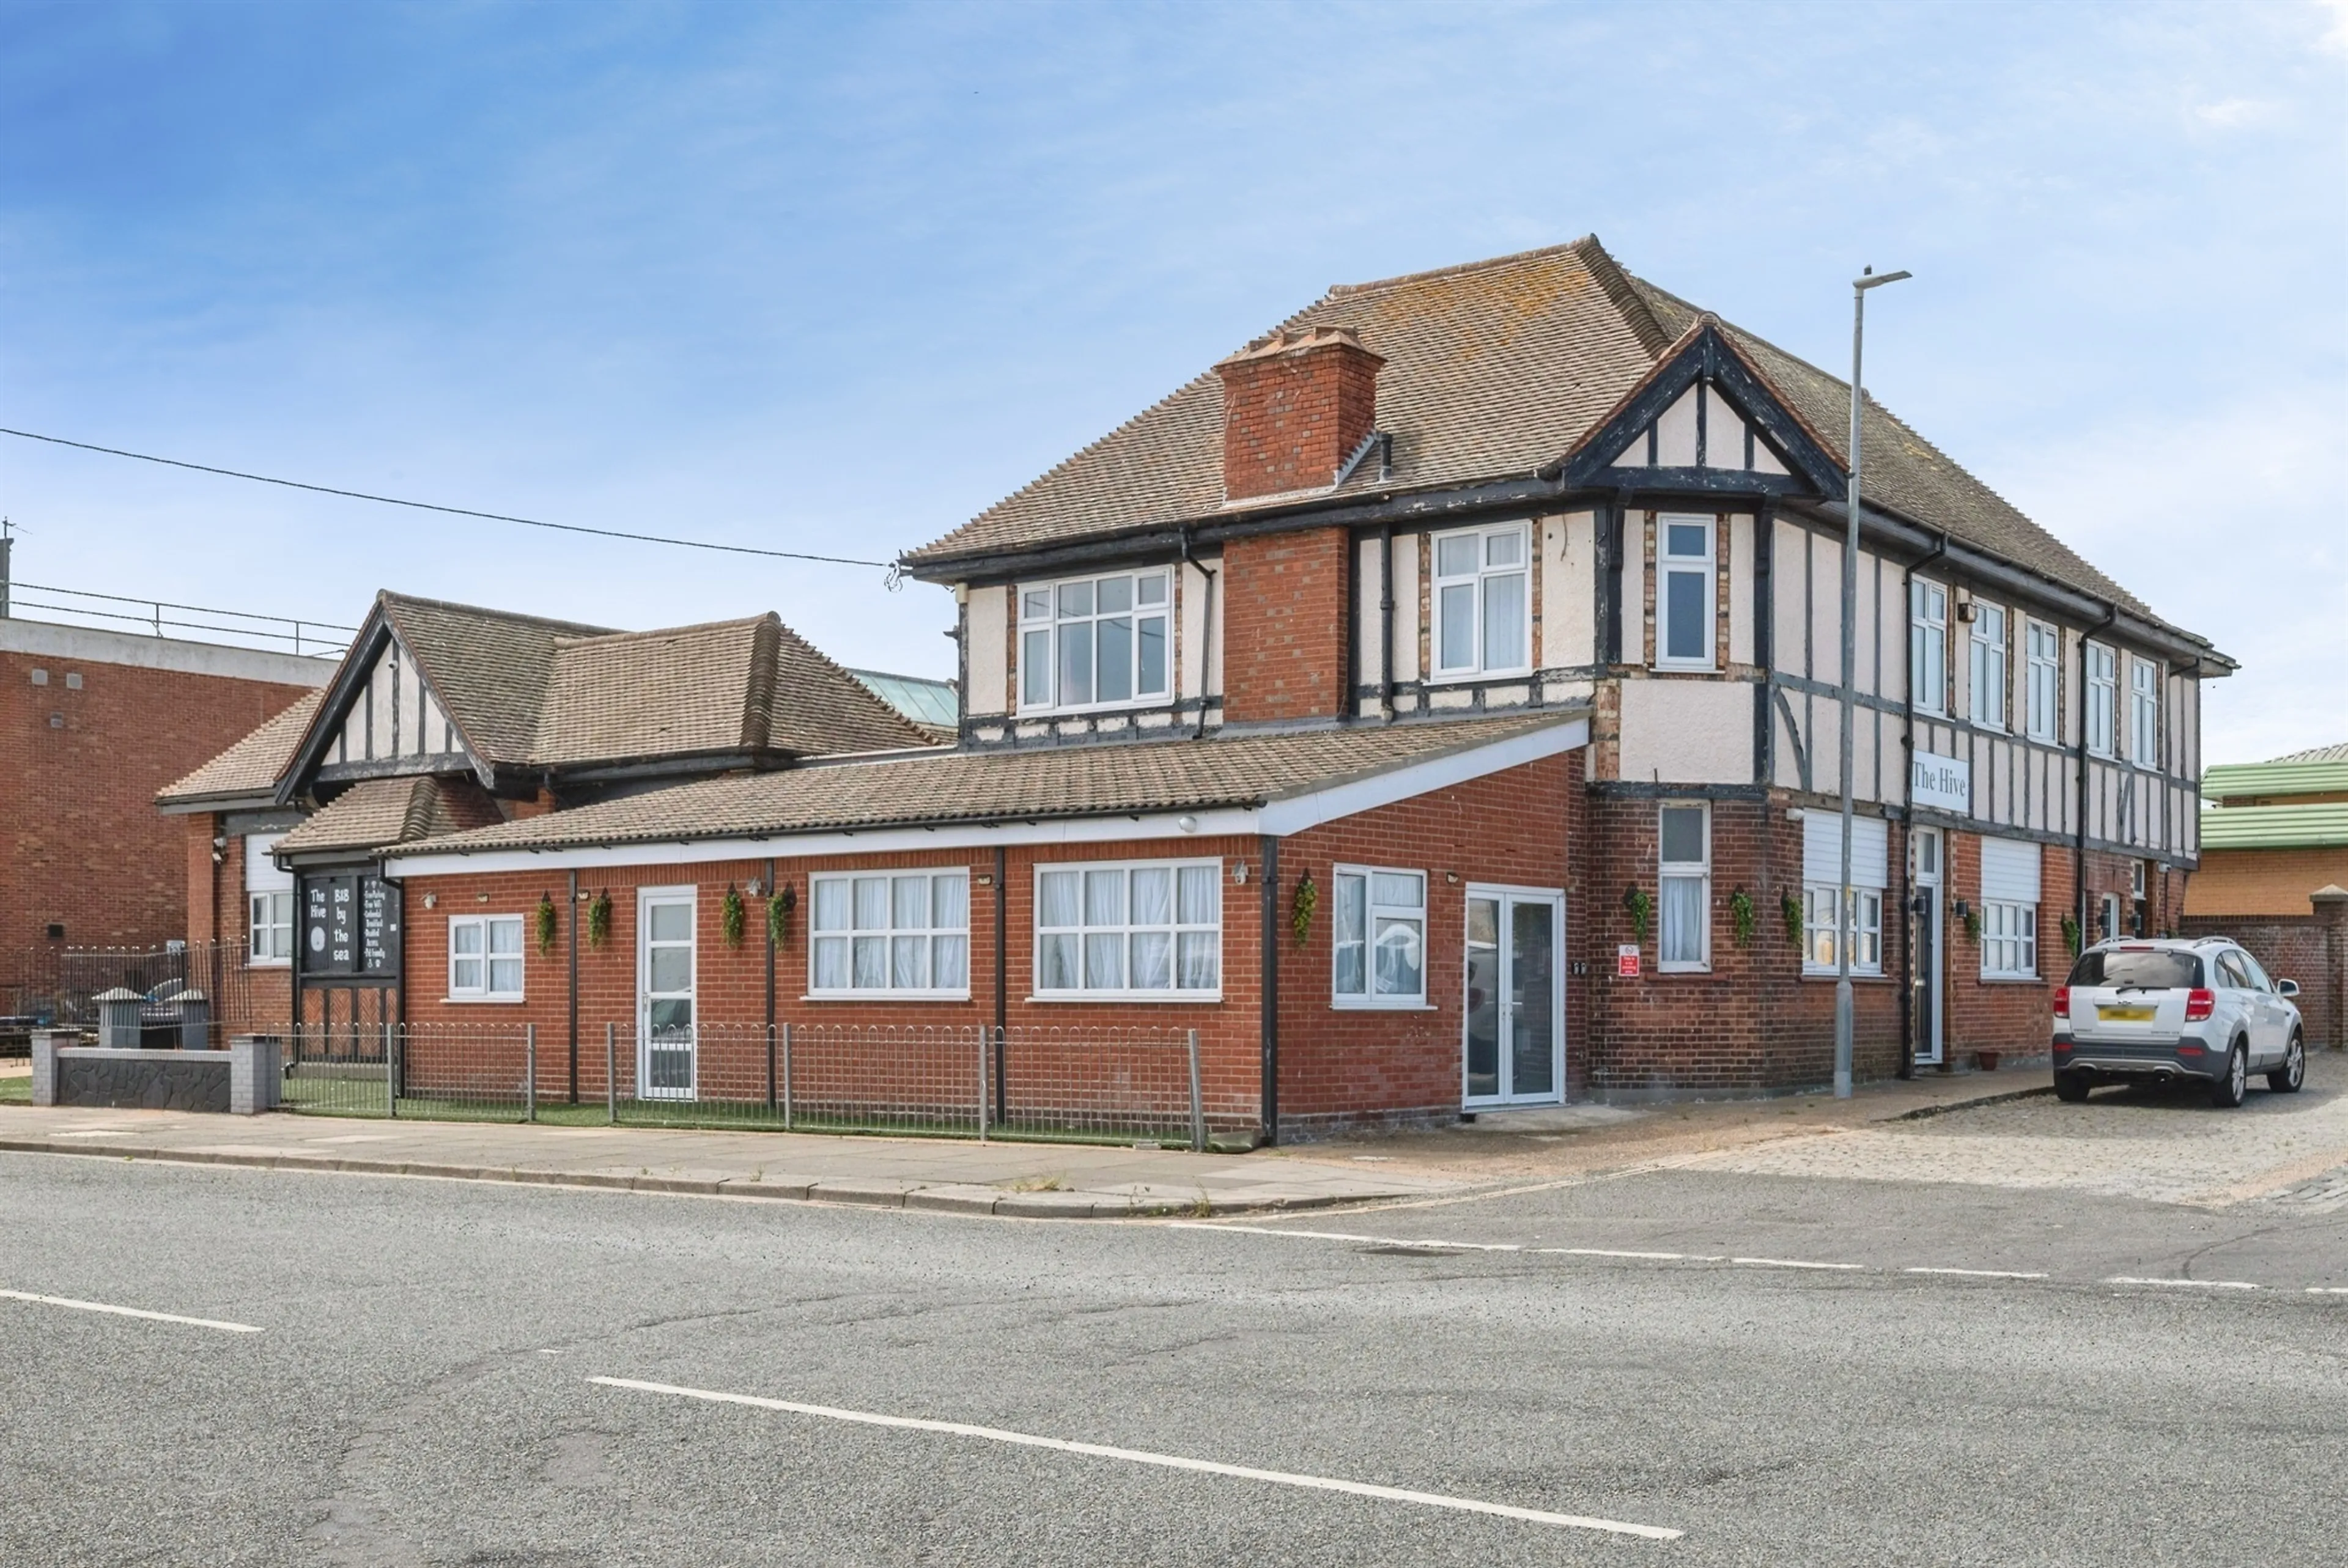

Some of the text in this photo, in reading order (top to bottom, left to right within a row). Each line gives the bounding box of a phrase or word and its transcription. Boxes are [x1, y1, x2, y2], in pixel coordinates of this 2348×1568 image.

[1913, 762, 1966, 797] The Hive
[311, 889, 325, 902] The
[311, 905, 326, 918] Hive
[337, 906, 346, 924] by
[334, 929, 348, 942] the
[333, 949, 349, 961] sea
